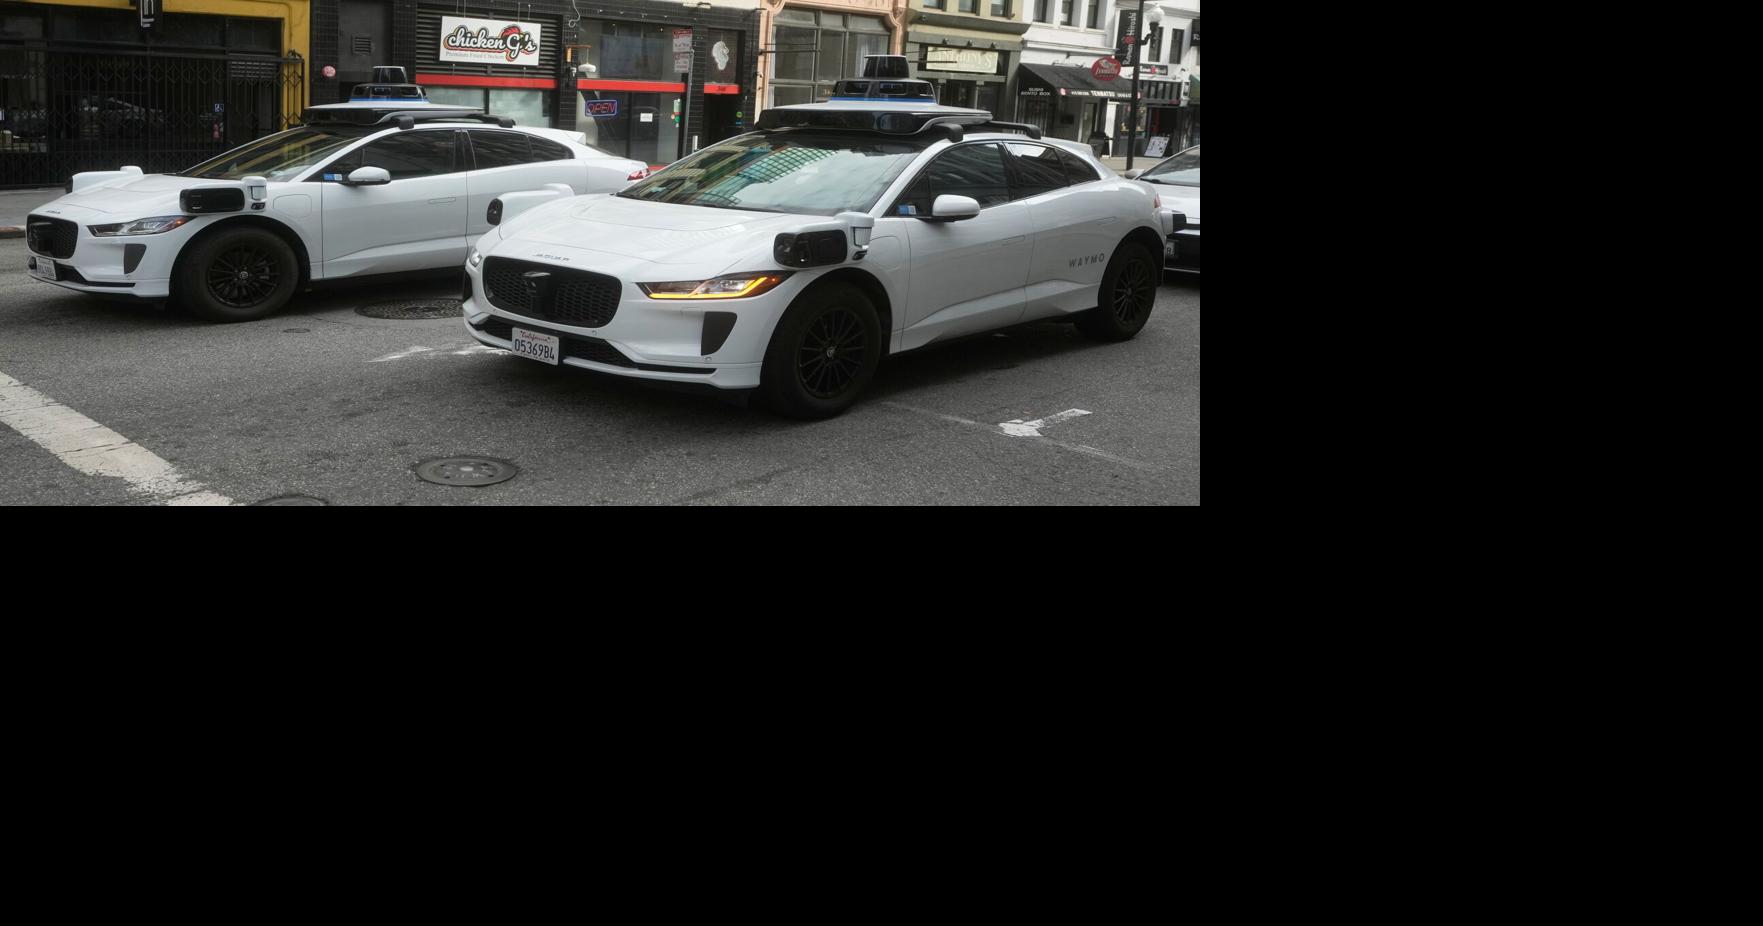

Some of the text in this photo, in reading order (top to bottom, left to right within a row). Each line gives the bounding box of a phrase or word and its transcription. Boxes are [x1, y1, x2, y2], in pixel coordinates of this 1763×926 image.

[447, 27, 537, 59] chicken G's
[588, 102, 616, 113] OPEN
[1068, 253, 1105, 267] WAYMO
[514, 338, 555, 361] 05369B4
